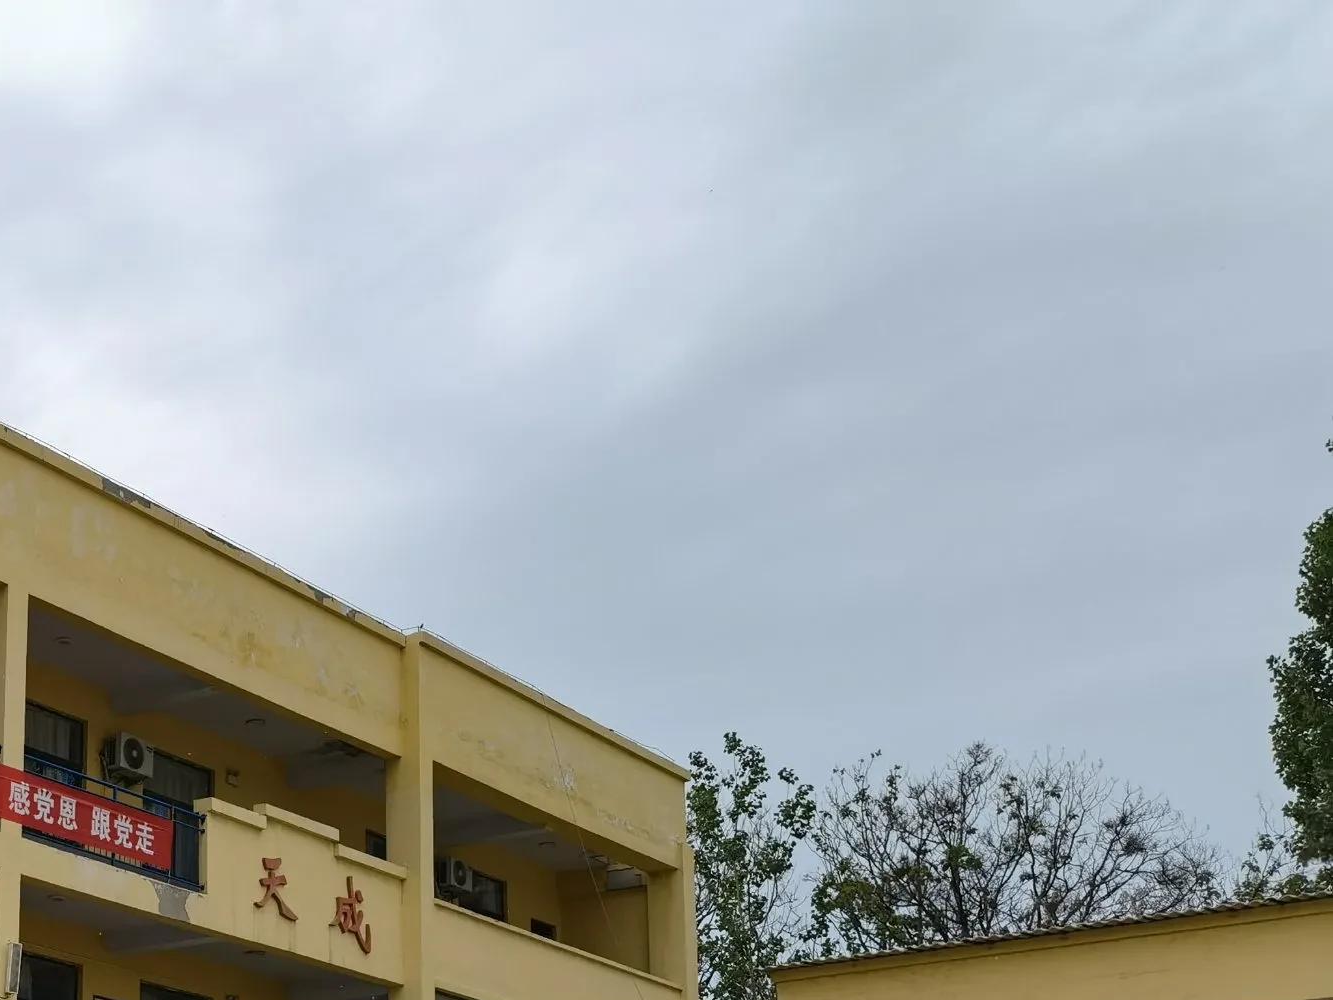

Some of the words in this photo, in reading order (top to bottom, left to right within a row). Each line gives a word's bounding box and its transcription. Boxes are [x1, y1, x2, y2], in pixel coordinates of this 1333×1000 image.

[8, 781, 78, 831] 感党恩
[90, 807, 155, 856] 跟党走
[254, 857, 297, 922] 天
[330, 876, 371, 955] 成
